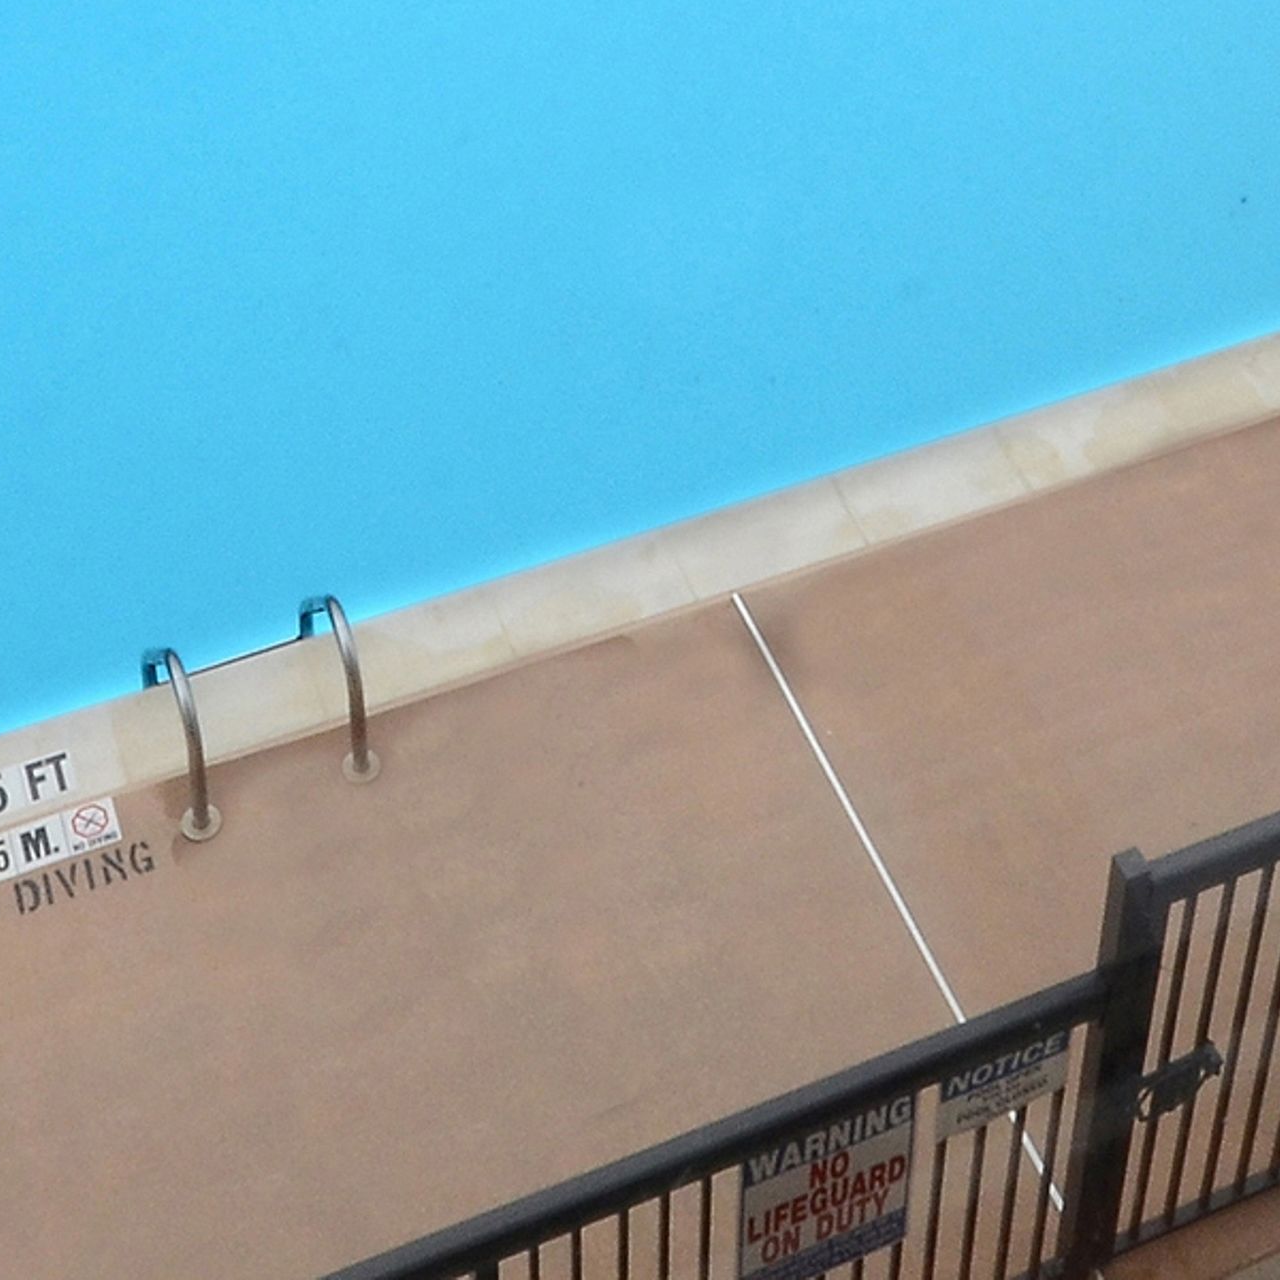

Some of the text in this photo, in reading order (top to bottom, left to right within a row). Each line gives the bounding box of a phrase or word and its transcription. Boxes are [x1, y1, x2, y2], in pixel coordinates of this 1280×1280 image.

[24, 752, 69, 801] FT
[13, 841, 156, 915] DIVING
[20, 826, 61, 863] M.
[946, 1031, 1067, 1098] NOTICE
[748, 1095, 912, 1185] WARNING
[810, 1151, 850, 1190] NO
[747, 1155, 906, 1246] LIFEGUARD
[760, 1227, 801, 1265] ON
[815, 1190, 893, 1242] DUTY
